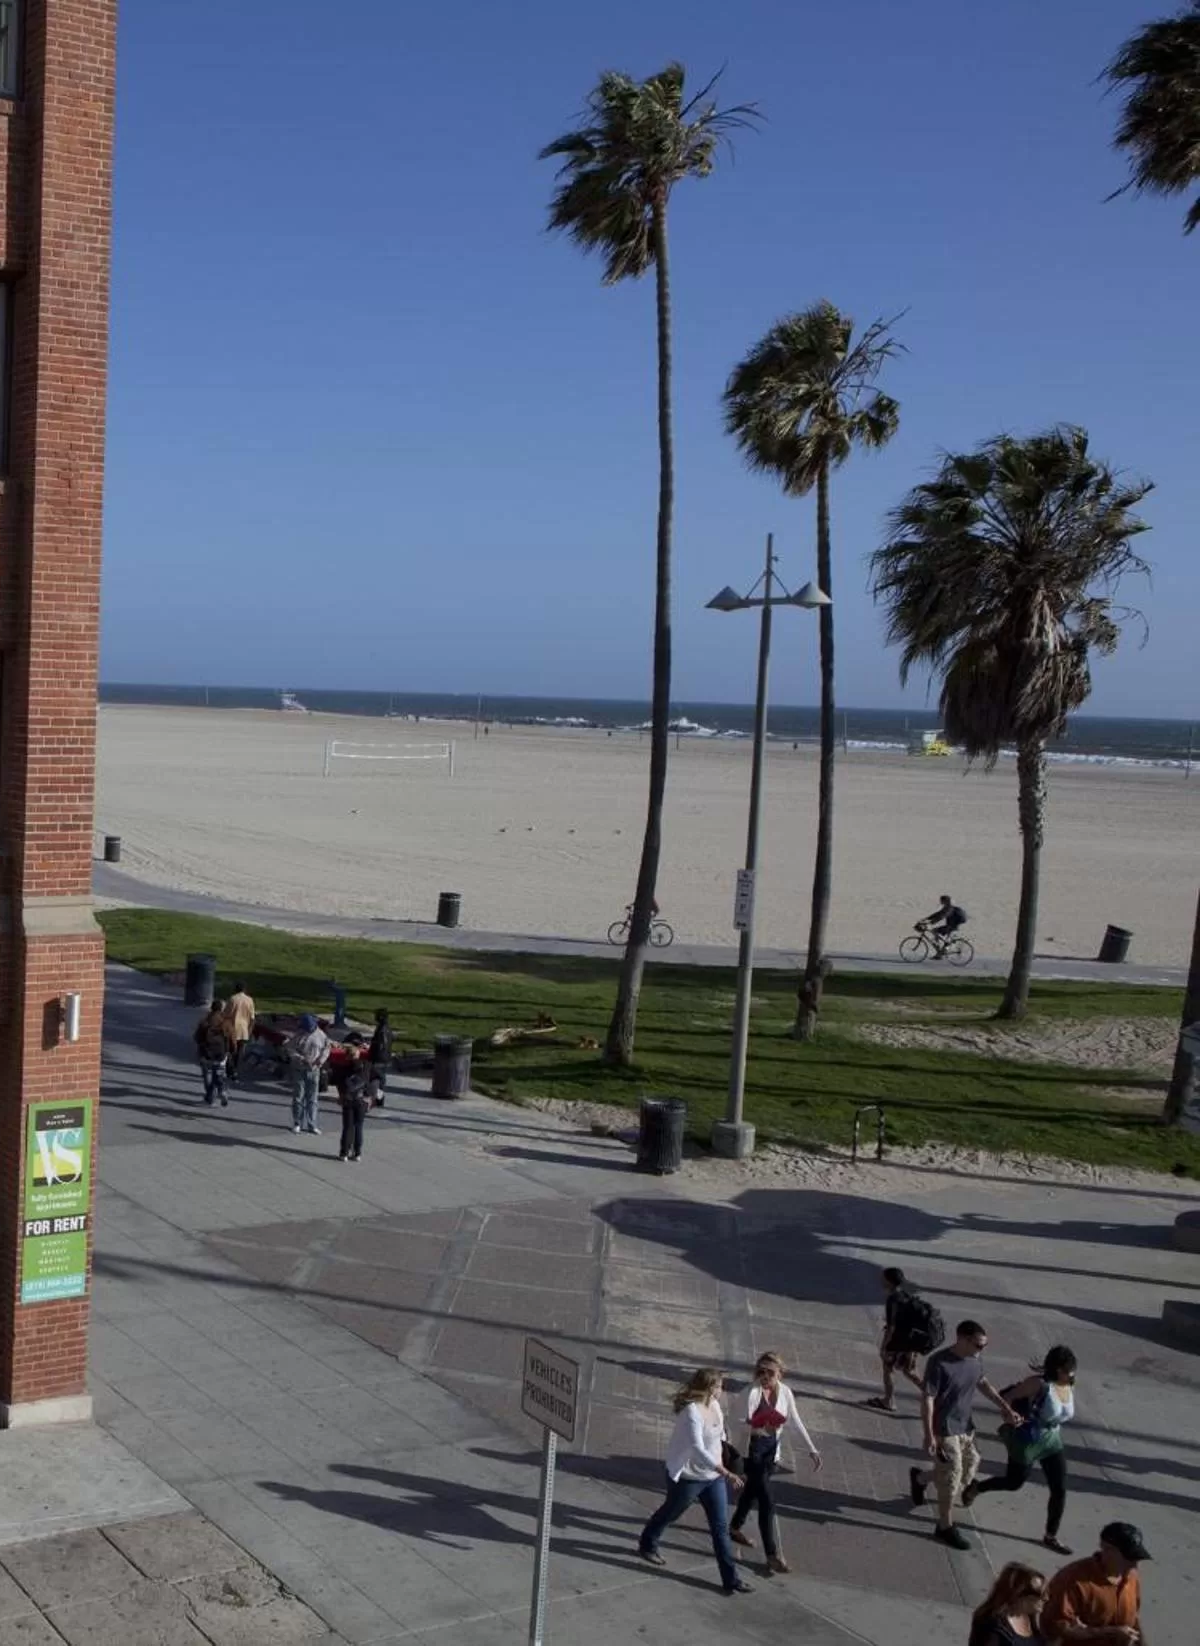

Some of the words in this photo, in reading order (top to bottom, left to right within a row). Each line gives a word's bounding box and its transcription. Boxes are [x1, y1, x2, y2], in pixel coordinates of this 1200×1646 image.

[25, 1218, 50, 1236] FOR
[53, 1215, 87, 1234] RENT
[529, 1356, 573, 1395] VEHICLES
